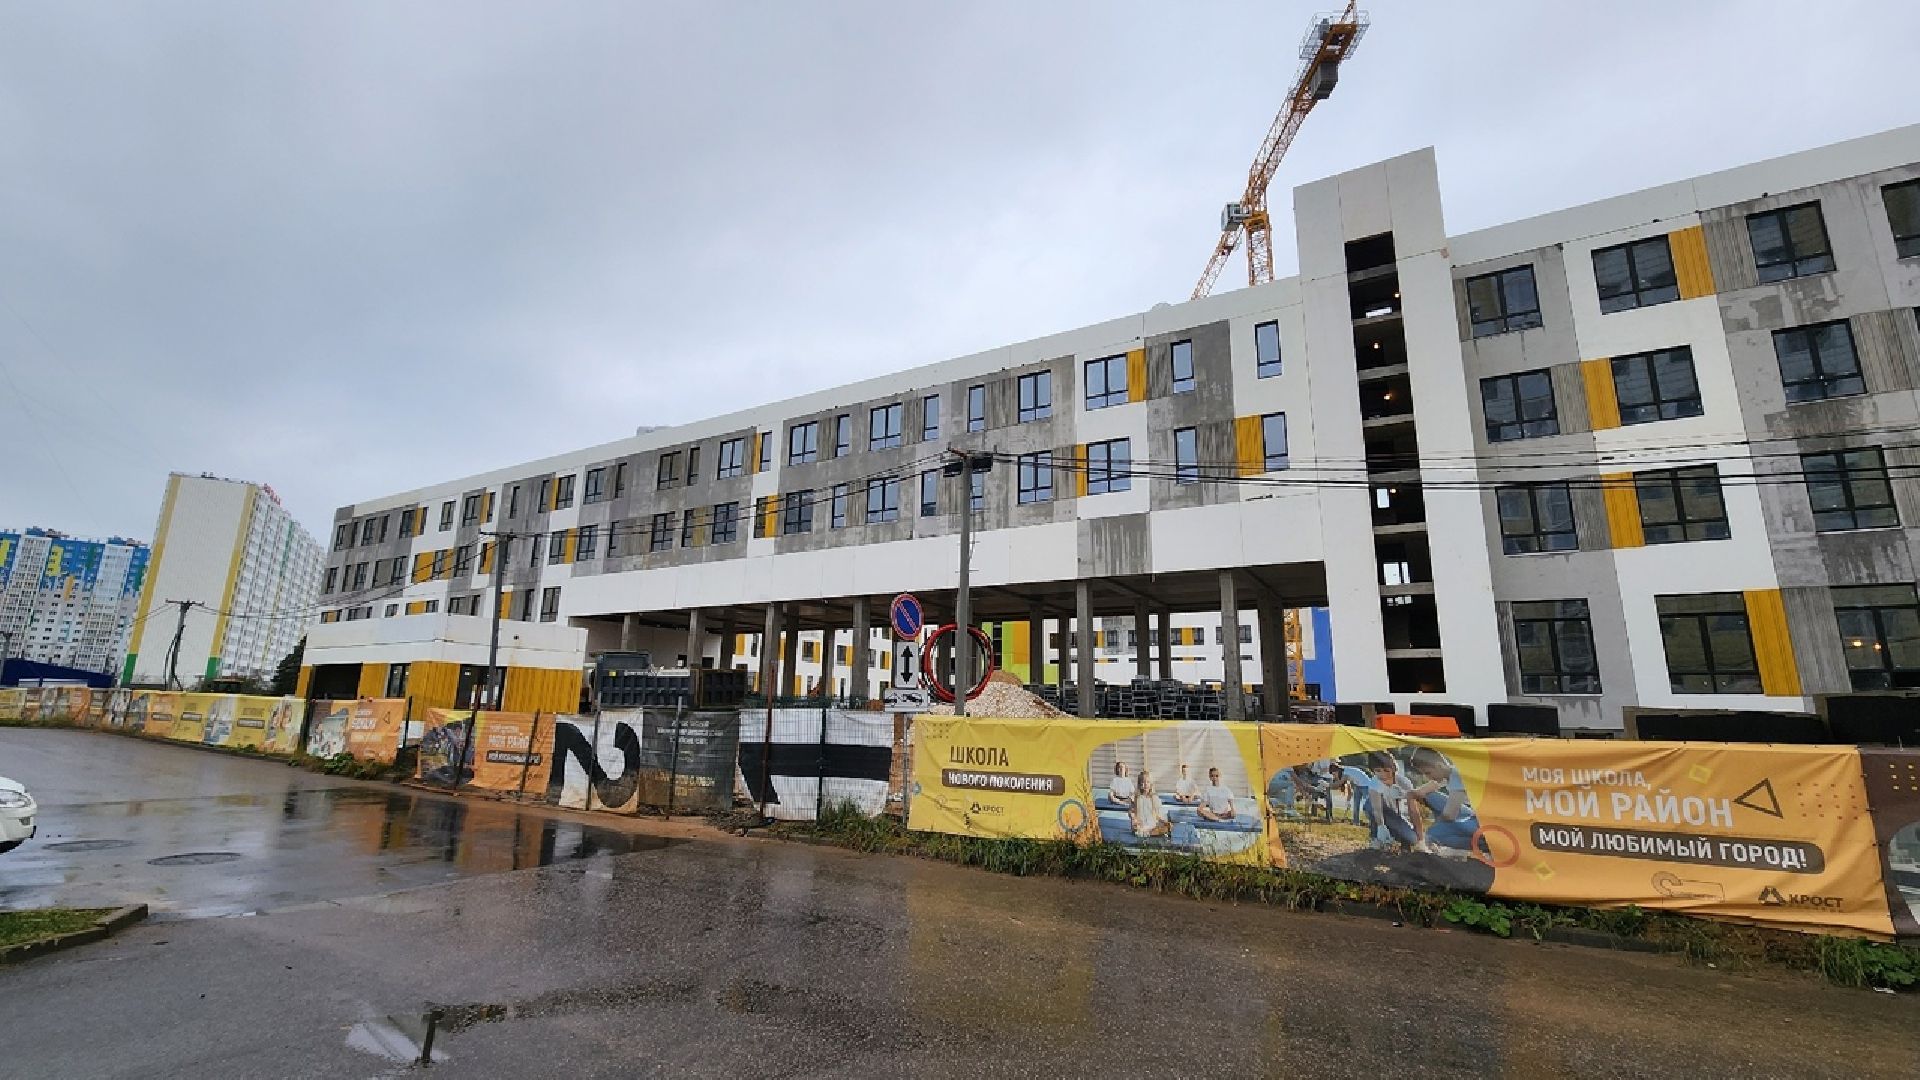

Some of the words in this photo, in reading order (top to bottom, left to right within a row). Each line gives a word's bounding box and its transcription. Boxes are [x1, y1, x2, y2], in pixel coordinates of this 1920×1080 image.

[950, 745, 1009, 767] ШКОЛА
[948, 772, 988, 787] НОВОГО
[989, 774, 1053, 791] ПОКОЛЕНИЯ
[1522, 767, 1565, 784] МОЯ
[1571, 768, 1652, 791] ШКОЛА,
[1525, 784, 1600, 818] МОЙ
[1610, 788, 1734, 828] РАЙОН
[1539, 827, 1585, 848] МОЙ
[1590, 831, 1713, 860] ЛЮБИМЫЙ
[1718, 842, 1807, 869] ГОРОД!
[1788, 893, 1844, 908] КРОСТ
